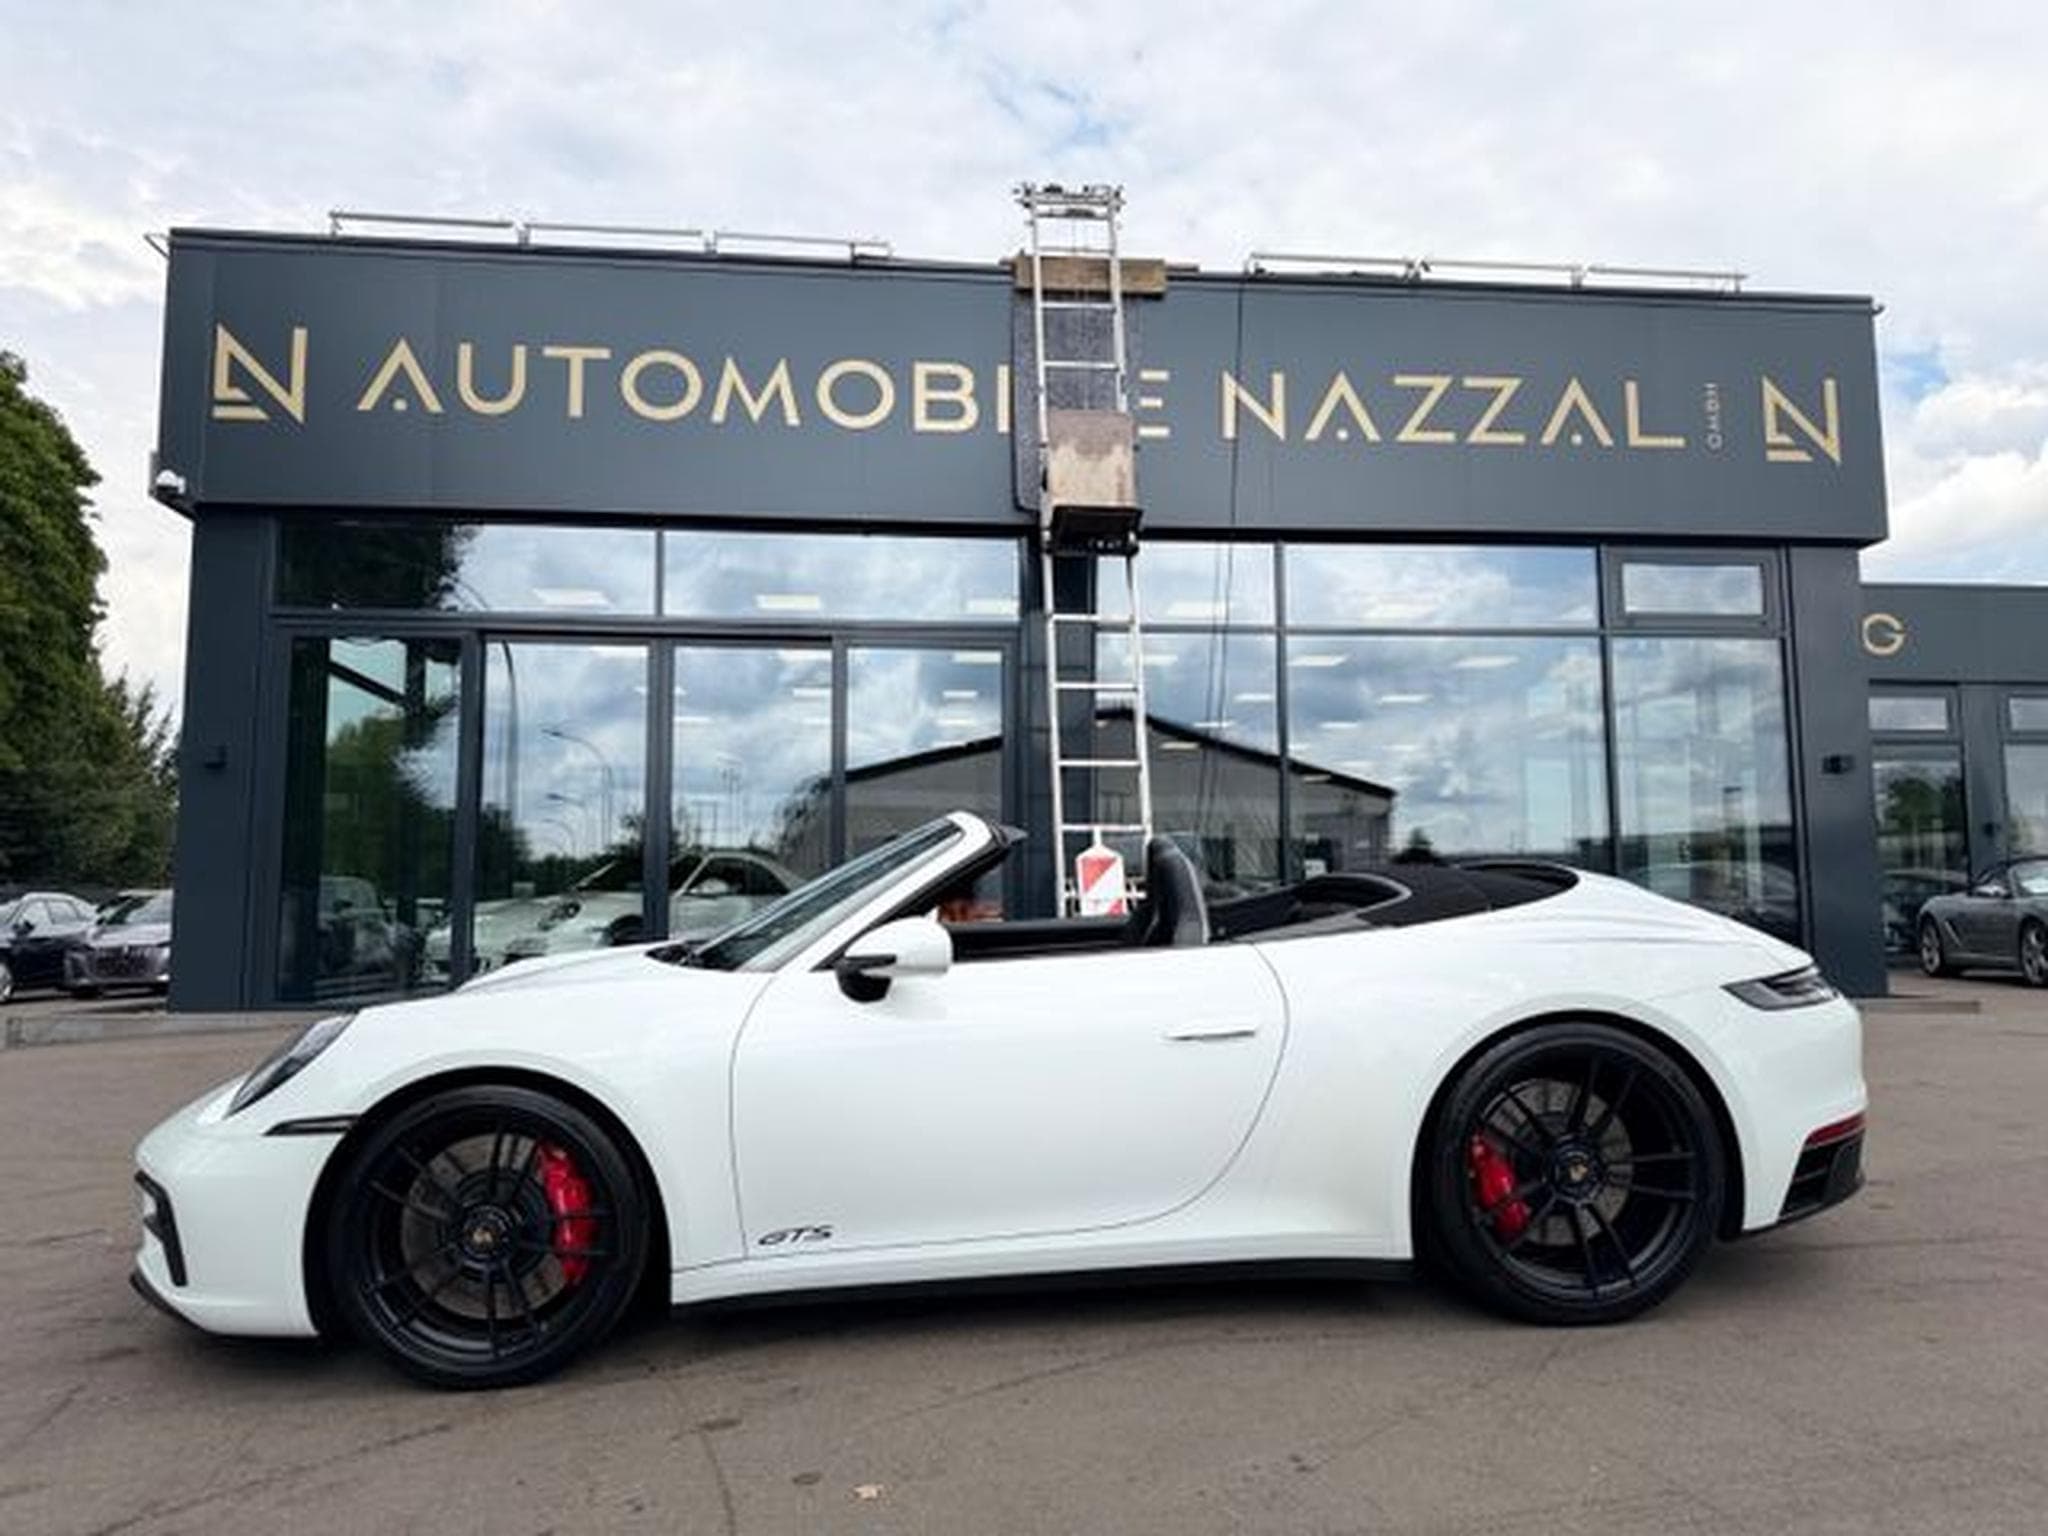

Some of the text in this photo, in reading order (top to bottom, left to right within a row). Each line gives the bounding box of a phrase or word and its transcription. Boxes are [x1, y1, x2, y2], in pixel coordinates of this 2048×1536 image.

[357, 338, 1687, 449] AUTOMOBIE NAZZAL
[1862, 613, 1906, 656] G
[758, 1224, 834, 1246] GTS
